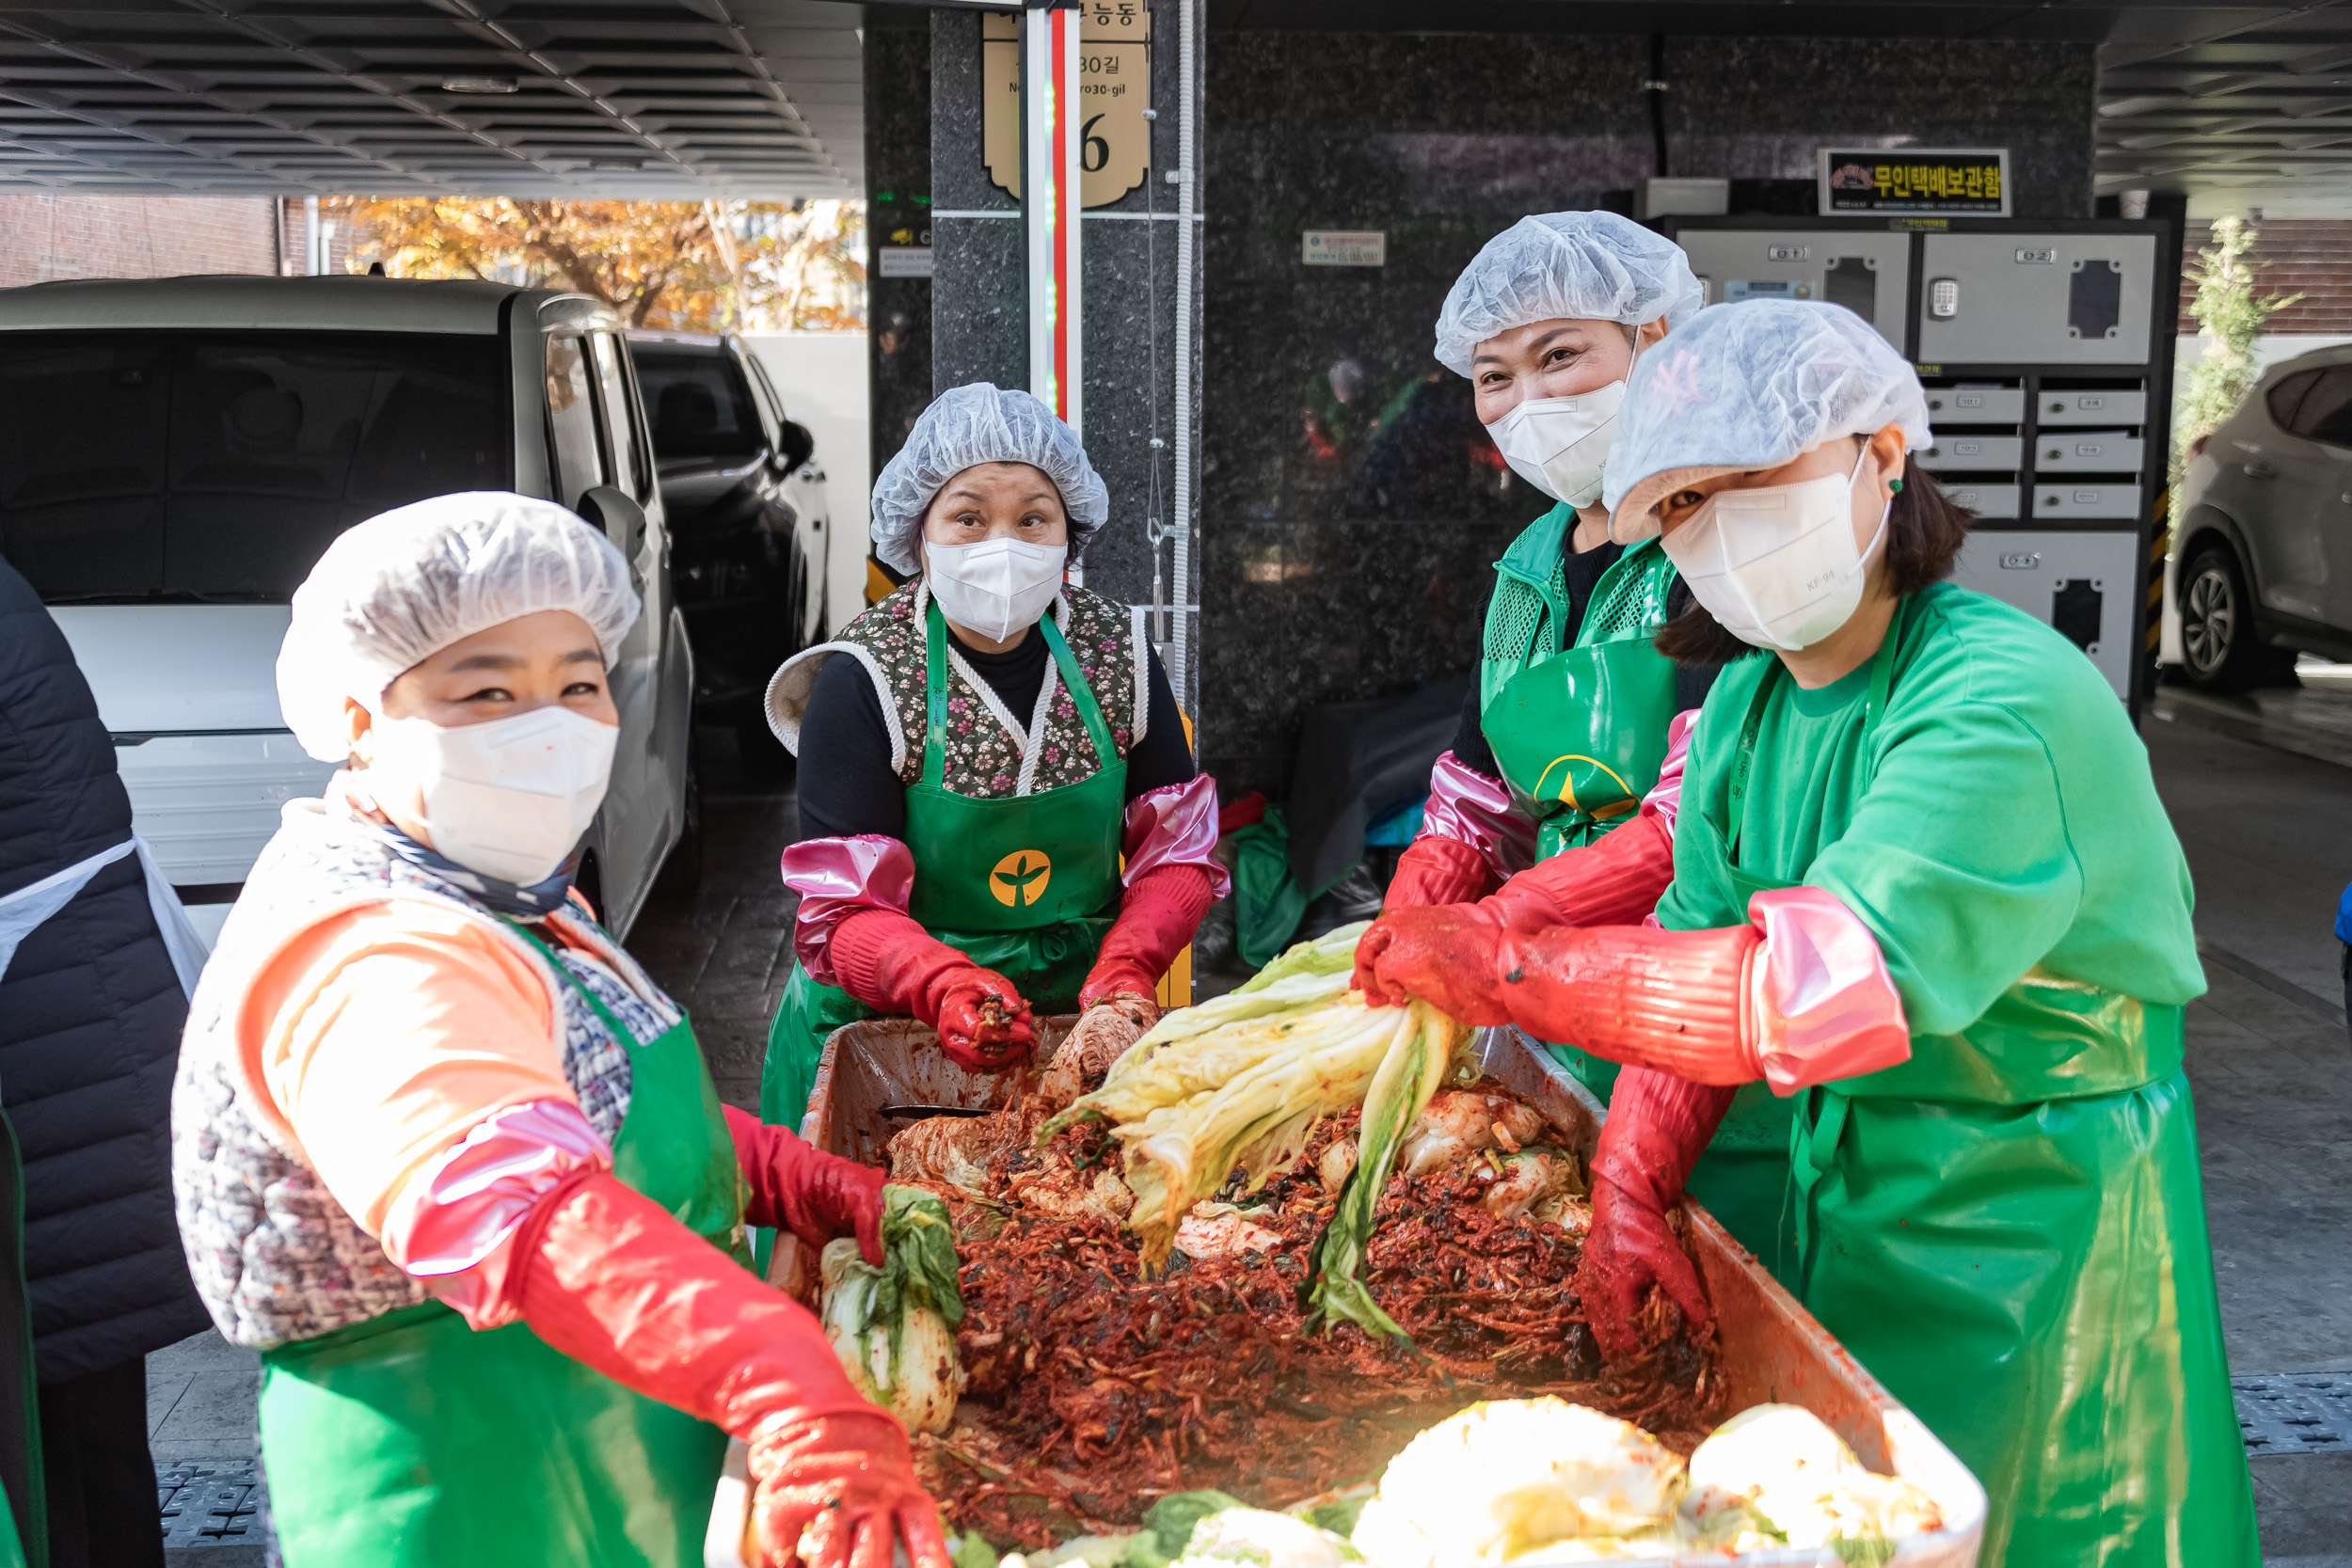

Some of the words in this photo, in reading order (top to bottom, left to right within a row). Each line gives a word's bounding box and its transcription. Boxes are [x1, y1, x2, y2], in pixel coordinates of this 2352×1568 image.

[1080, 113, 1109, 173] 6
[1874, 165, 2000, 198] 무인택배보관함
[1777, 248, 1798, 259] 01
[2024, 250, 2046, 261] 02
